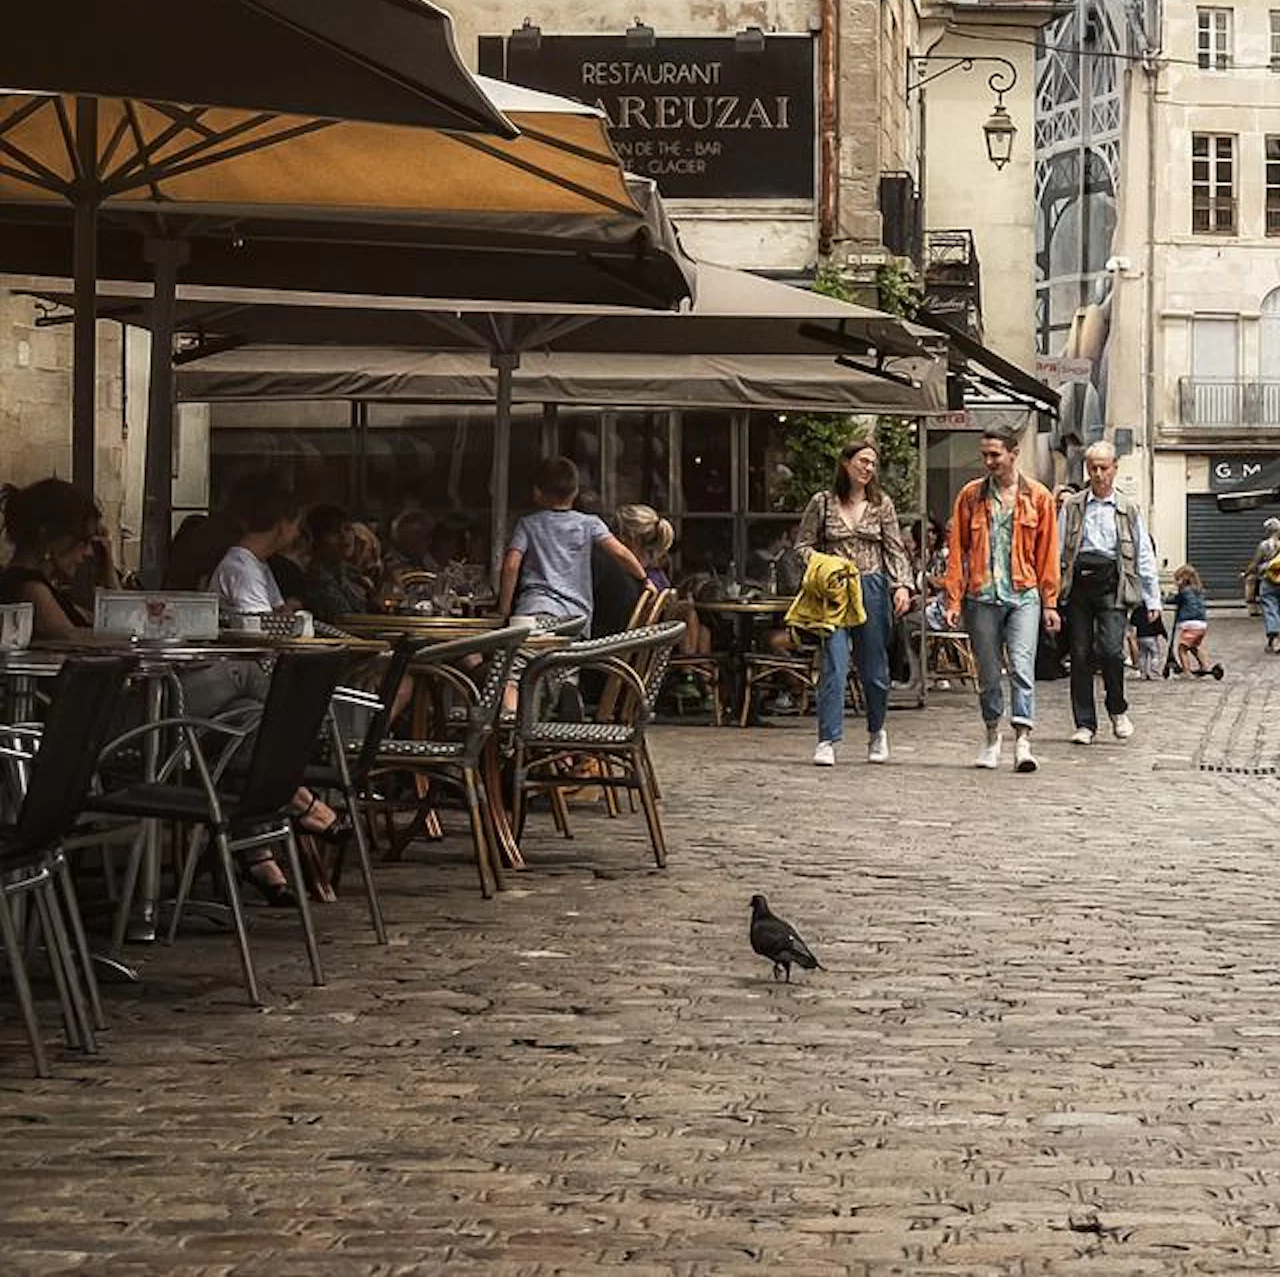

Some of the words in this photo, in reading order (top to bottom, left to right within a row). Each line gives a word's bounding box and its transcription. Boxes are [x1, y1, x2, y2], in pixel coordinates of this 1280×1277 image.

[582, 62, 721, 84] RESTAURANT
[572, 96, 790, 129] AREUZAI
[695, 141, 721, 156] BAR
[648, 159, 705, 174] GLACIER
